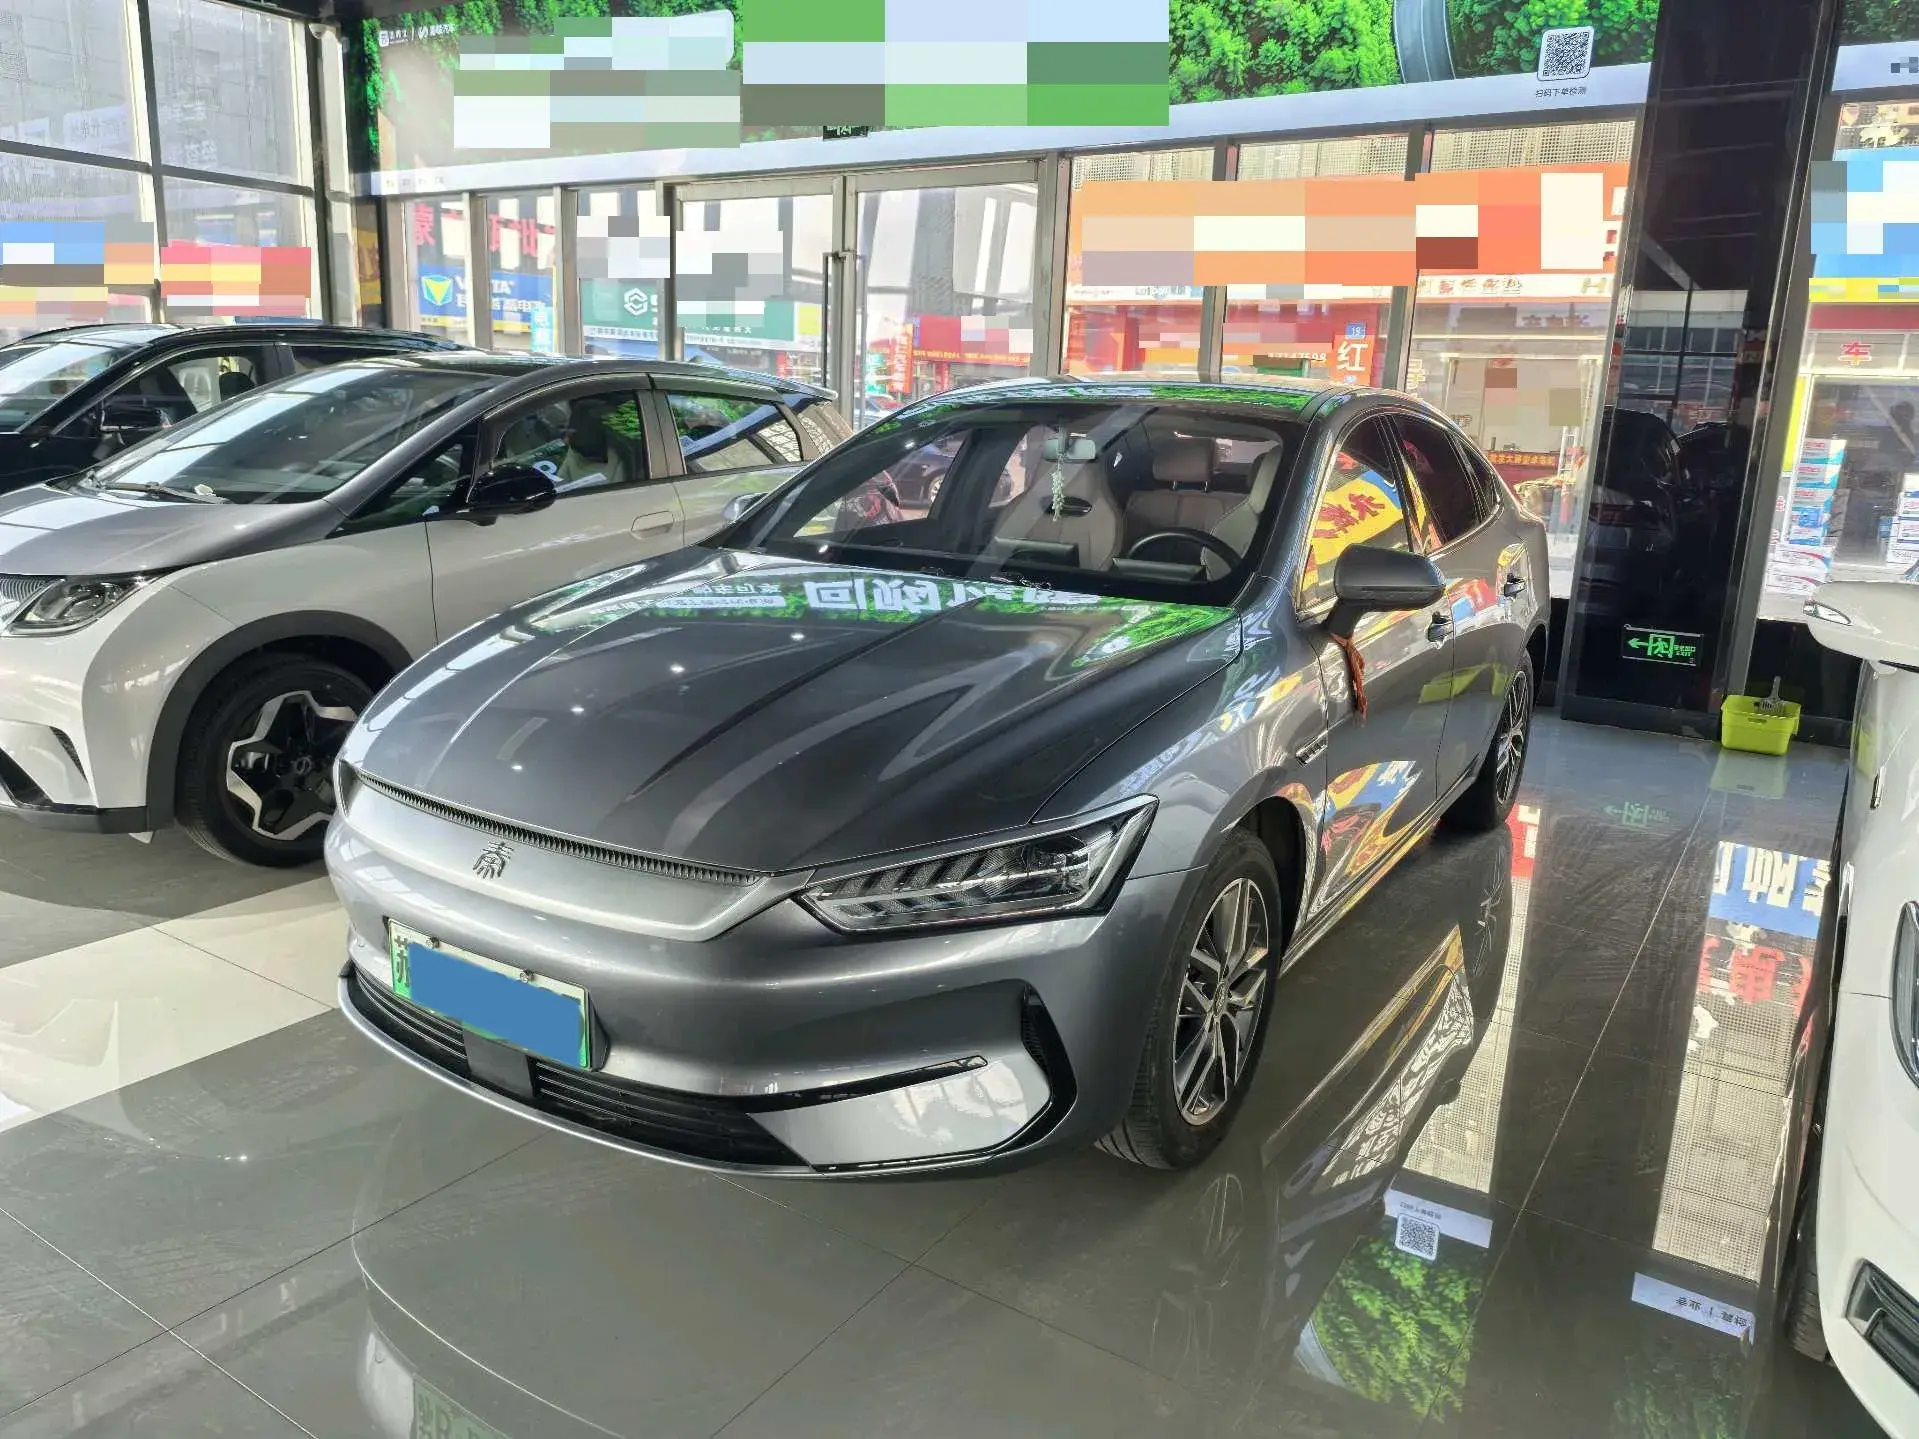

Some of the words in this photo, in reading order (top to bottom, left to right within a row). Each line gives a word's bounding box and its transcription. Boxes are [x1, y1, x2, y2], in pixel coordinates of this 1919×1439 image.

[1336, 340, 1369, 372] 红
[1839, 341, 1872, 366] 车
[473, 841, 515, 879] 秦
